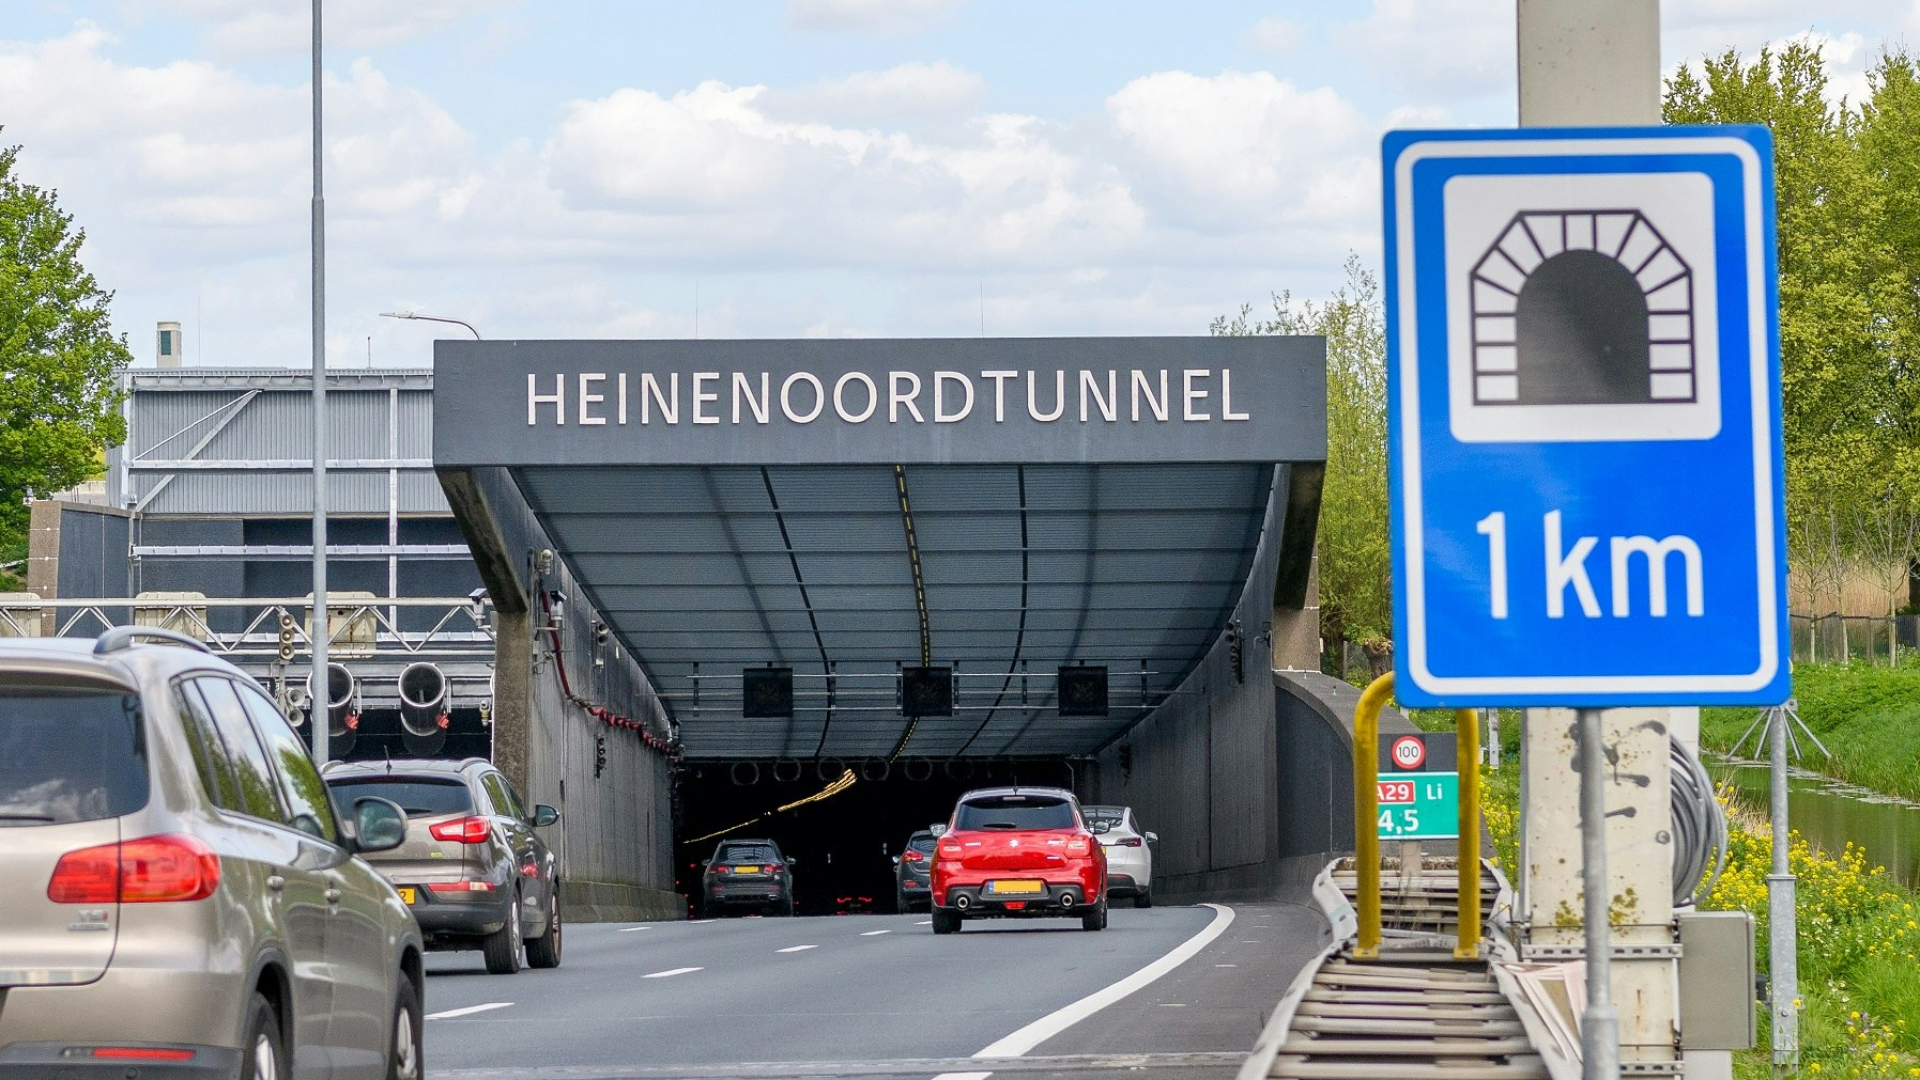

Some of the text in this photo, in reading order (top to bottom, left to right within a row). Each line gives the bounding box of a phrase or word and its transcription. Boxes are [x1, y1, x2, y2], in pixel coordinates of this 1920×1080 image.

[527, 369, 1250, 425] HEINENOORDTUNNEL
[1476, 509, 1705, 620] 1 km
[1398, 746, 1419, 758] 100
[1426, 783, 1443, 800] Li
